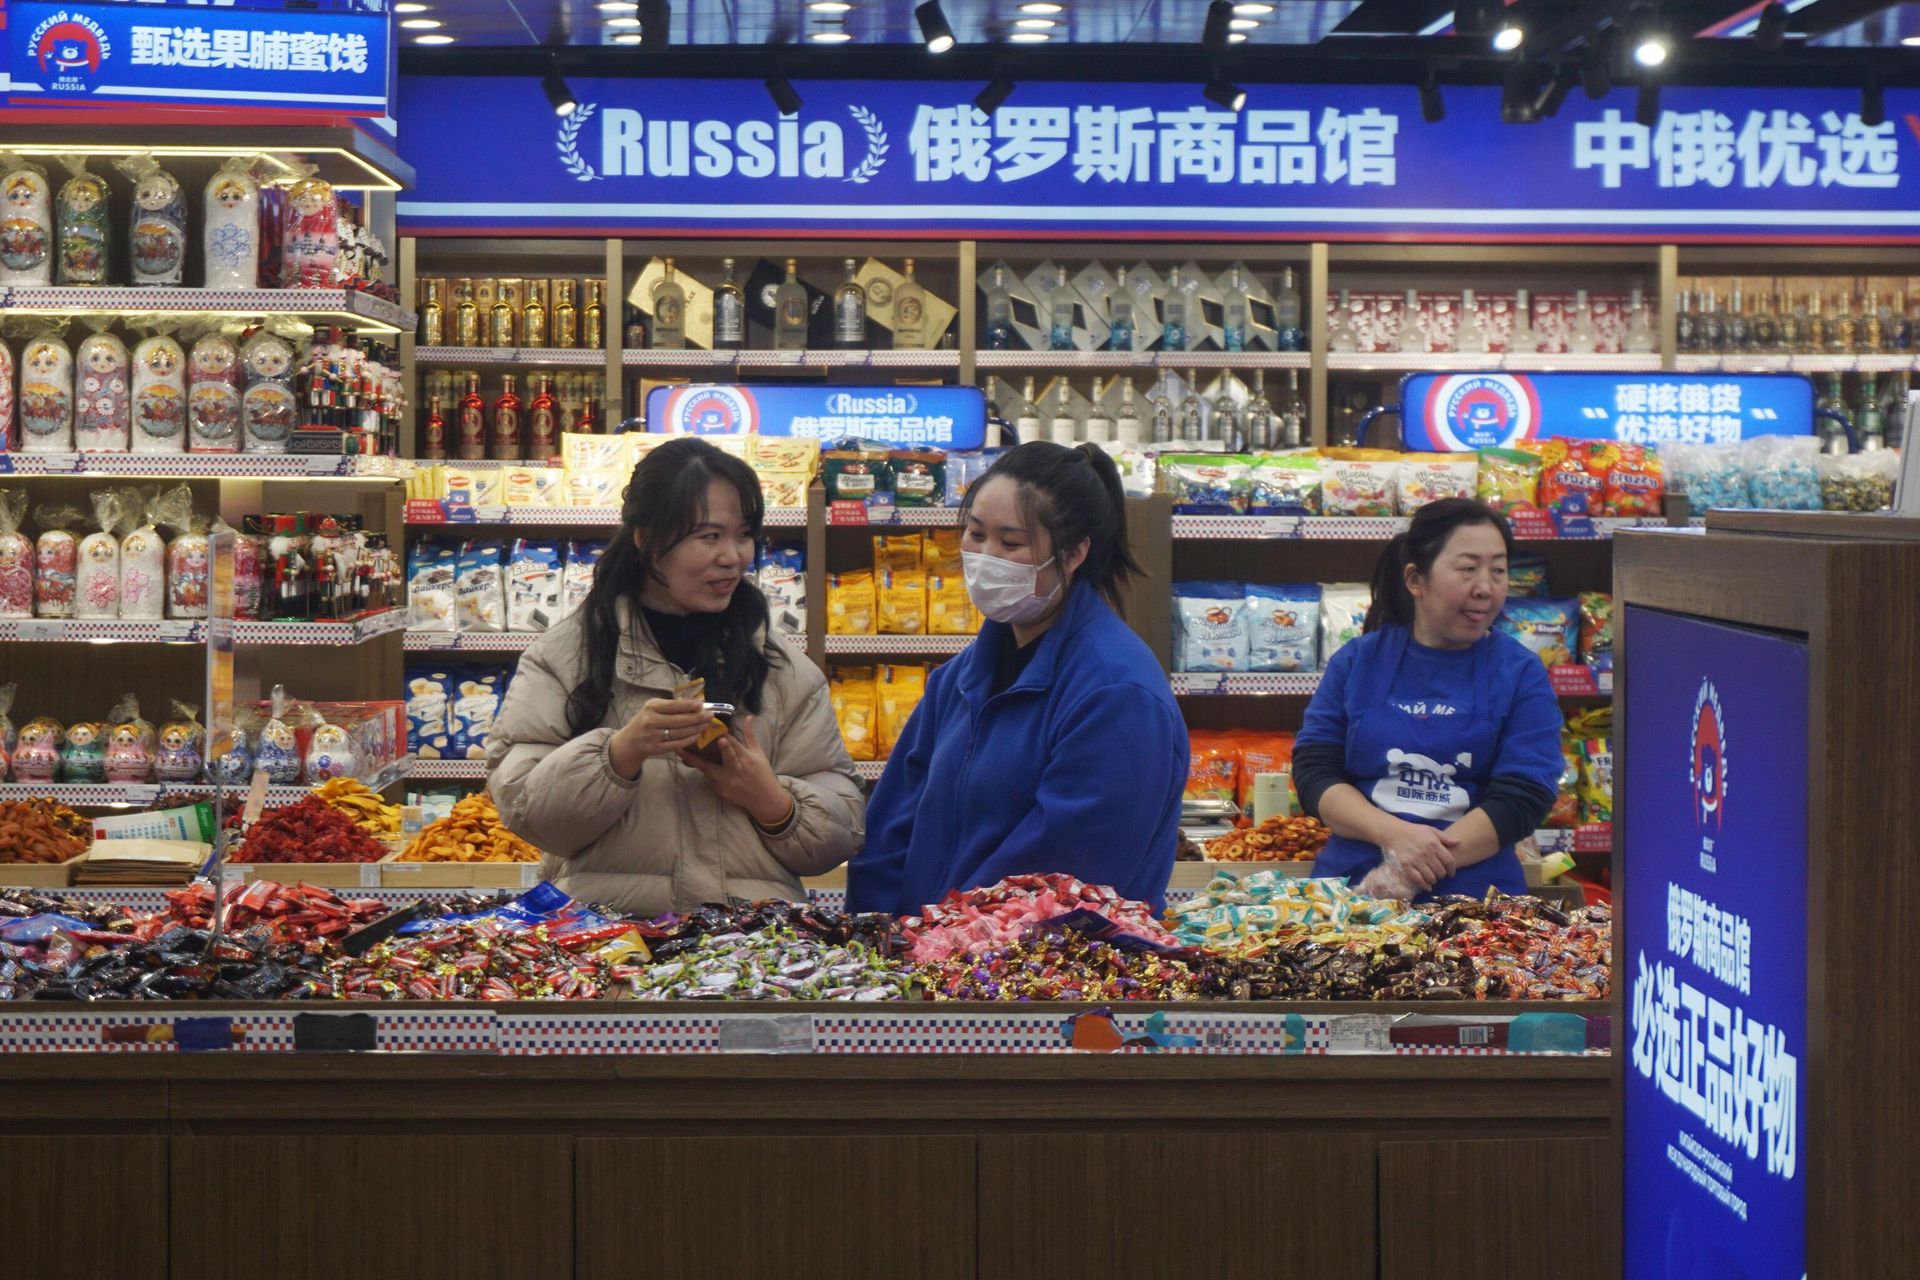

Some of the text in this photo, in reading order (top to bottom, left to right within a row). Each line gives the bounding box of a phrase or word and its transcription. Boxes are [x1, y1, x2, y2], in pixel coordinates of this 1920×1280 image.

[27, 10, 111, 60] РУССКИЙ МЕДВЕДЬ
[131, 26, 368, 73] 甄选果脯蜜饯
[51, 82, 87, 91] RUSSIA
[602, 107, 844, 178] Russia
[908, 104, 1398, 186] 俄罗斯商品馆
[1574, 109, 1900, 188] 中俄优选
[837, 394, 906, 414] Russia
[1616, 383, 1742, 413] 硬核俄货
[790, 416, 953, 442] 俄罗斯商品馆
[1616, 415, 1742, 443] 优选好物
[1667, 880, 1750, 997] 俄罗斯商品馆
[1633, 949, 1798, 1180] 必选正品好物
